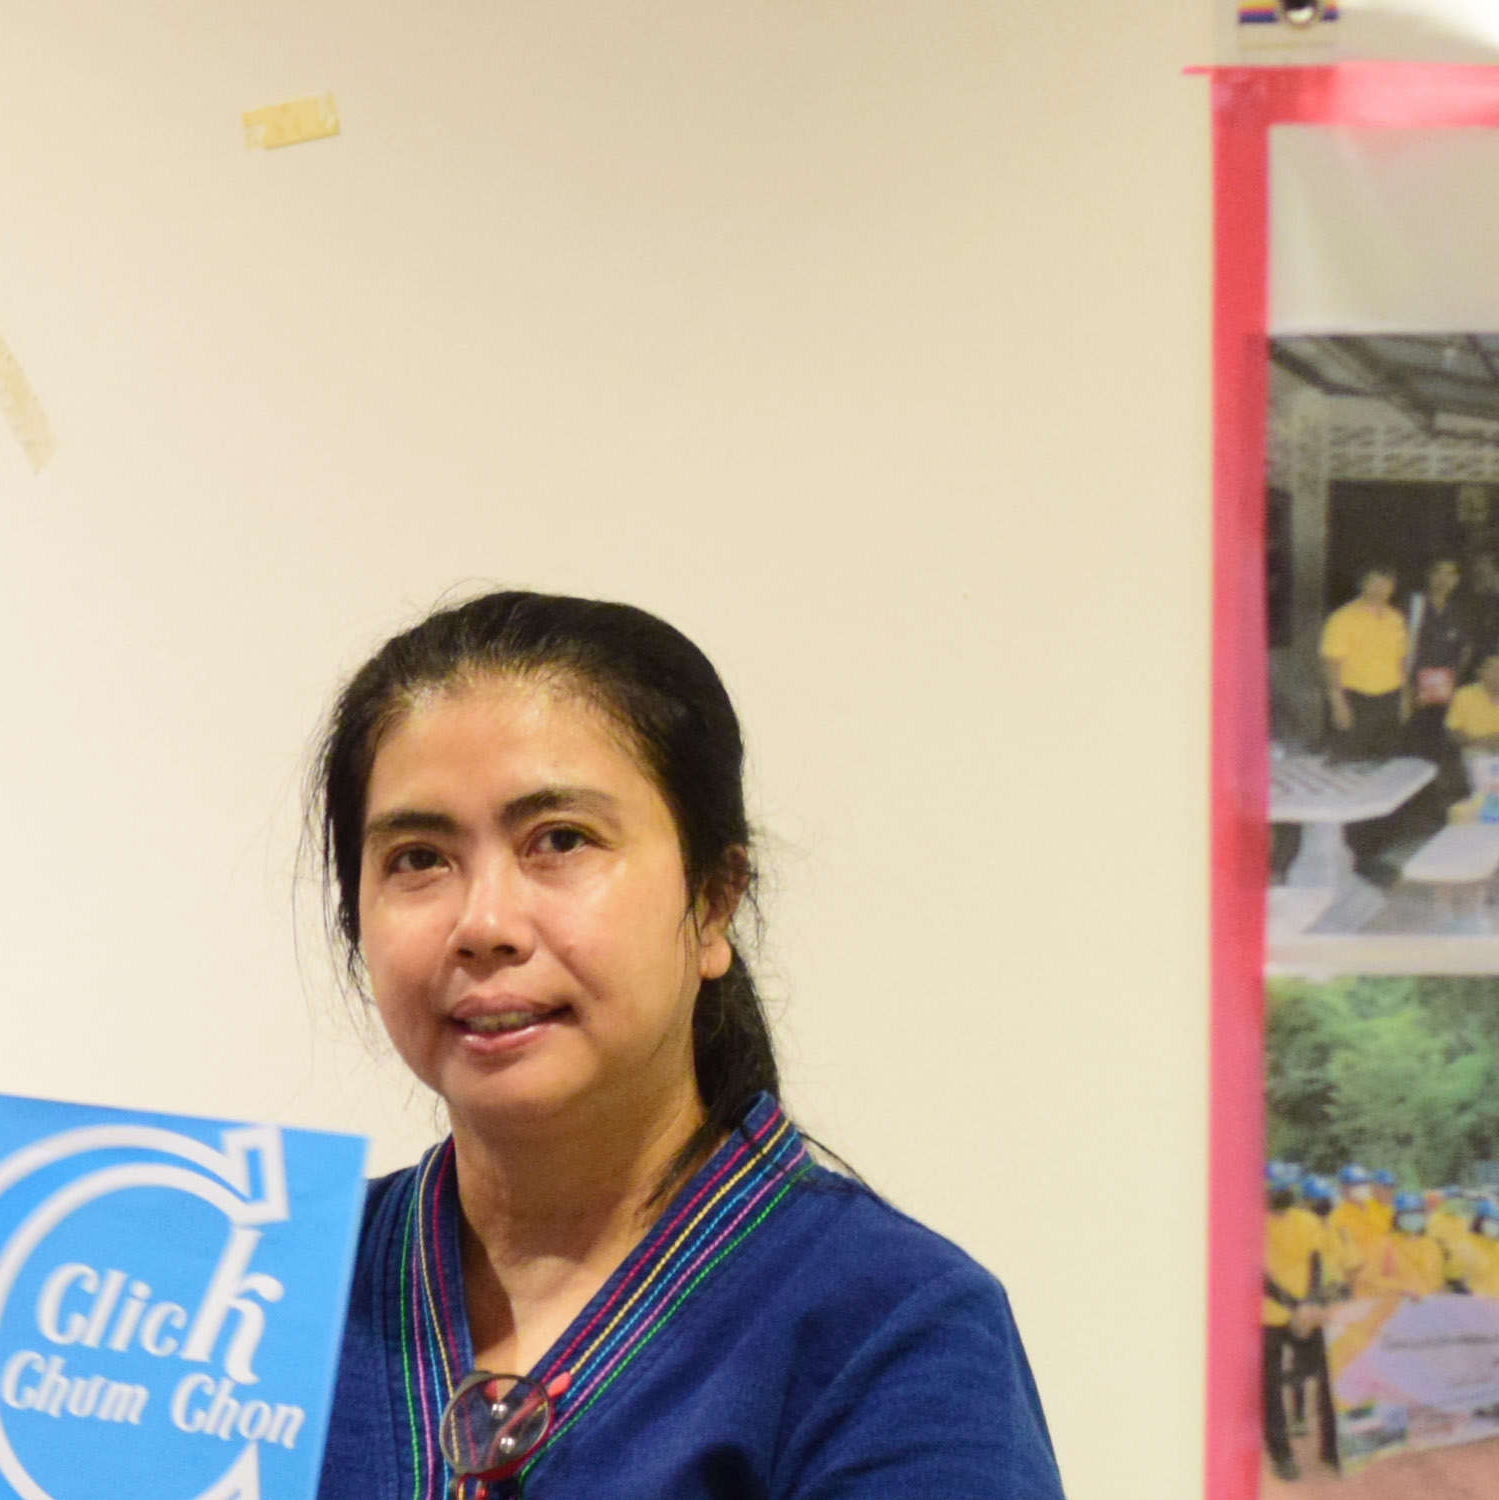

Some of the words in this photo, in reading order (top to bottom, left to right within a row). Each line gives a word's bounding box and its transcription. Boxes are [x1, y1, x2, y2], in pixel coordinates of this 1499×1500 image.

[36, 1226, 286, 1384] Click
[1, 1350, 150, 1426] Chum
[171, 1372, 305, 1450] Chon
